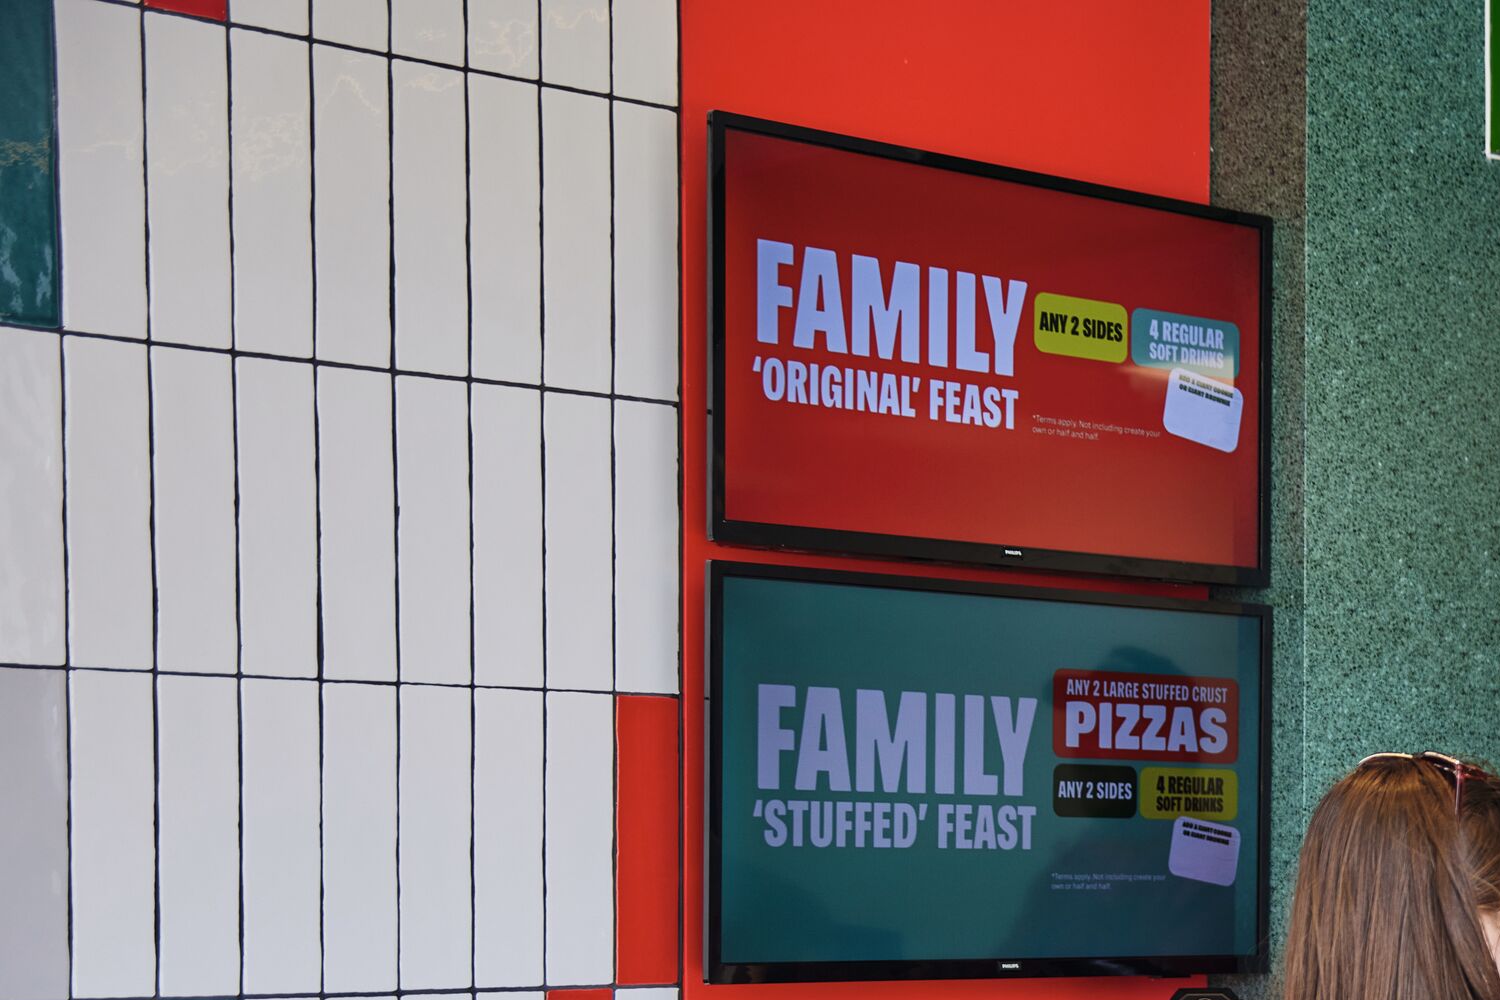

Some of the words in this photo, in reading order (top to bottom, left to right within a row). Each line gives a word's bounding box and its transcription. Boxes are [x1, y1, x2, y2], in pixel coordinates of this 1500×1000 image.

[756, 238, 1028, 378] FAMILY
[1039, 311, 1068, 334] ANY
[1070, 316, 1080, 336] 2
[1082, 318, 1124, 343] SIDES
[1149, 319, 1159, 340] 4
[1162, 321, 1224, 350] REGULAR
[1149, 342, 1179, 362] SOFT
[1181, 346, 1224, 369] DRINKS
[929, 379, 1019, 430] FEAST
[1066, 678, 1090, 696] ANY
[1093, 680, 1100, 696] 2
[1103, 681, 1139, 698] LARGE
[1142, 683, 1189, 702] STUFFED
[1192, 686, 1227, 703] CRUST
[757, 683, 1038, 796] FAMILY
[1066, 701, 1228, 754] PIZZAS
[1058, 781, 1083, 799] ANY
[1086, 781, 1094, 799] 2
[1096, 782, 1133, 800] SIDES
[1156, 775, 1165, 794] 4
[1168, 776, 1224, 796] REGULAR
[1156, 796, 1183, 812] SOFT
[1184, 797, 1223, 813] DRINKS
[937, 804, 1037, 851] FEAST
